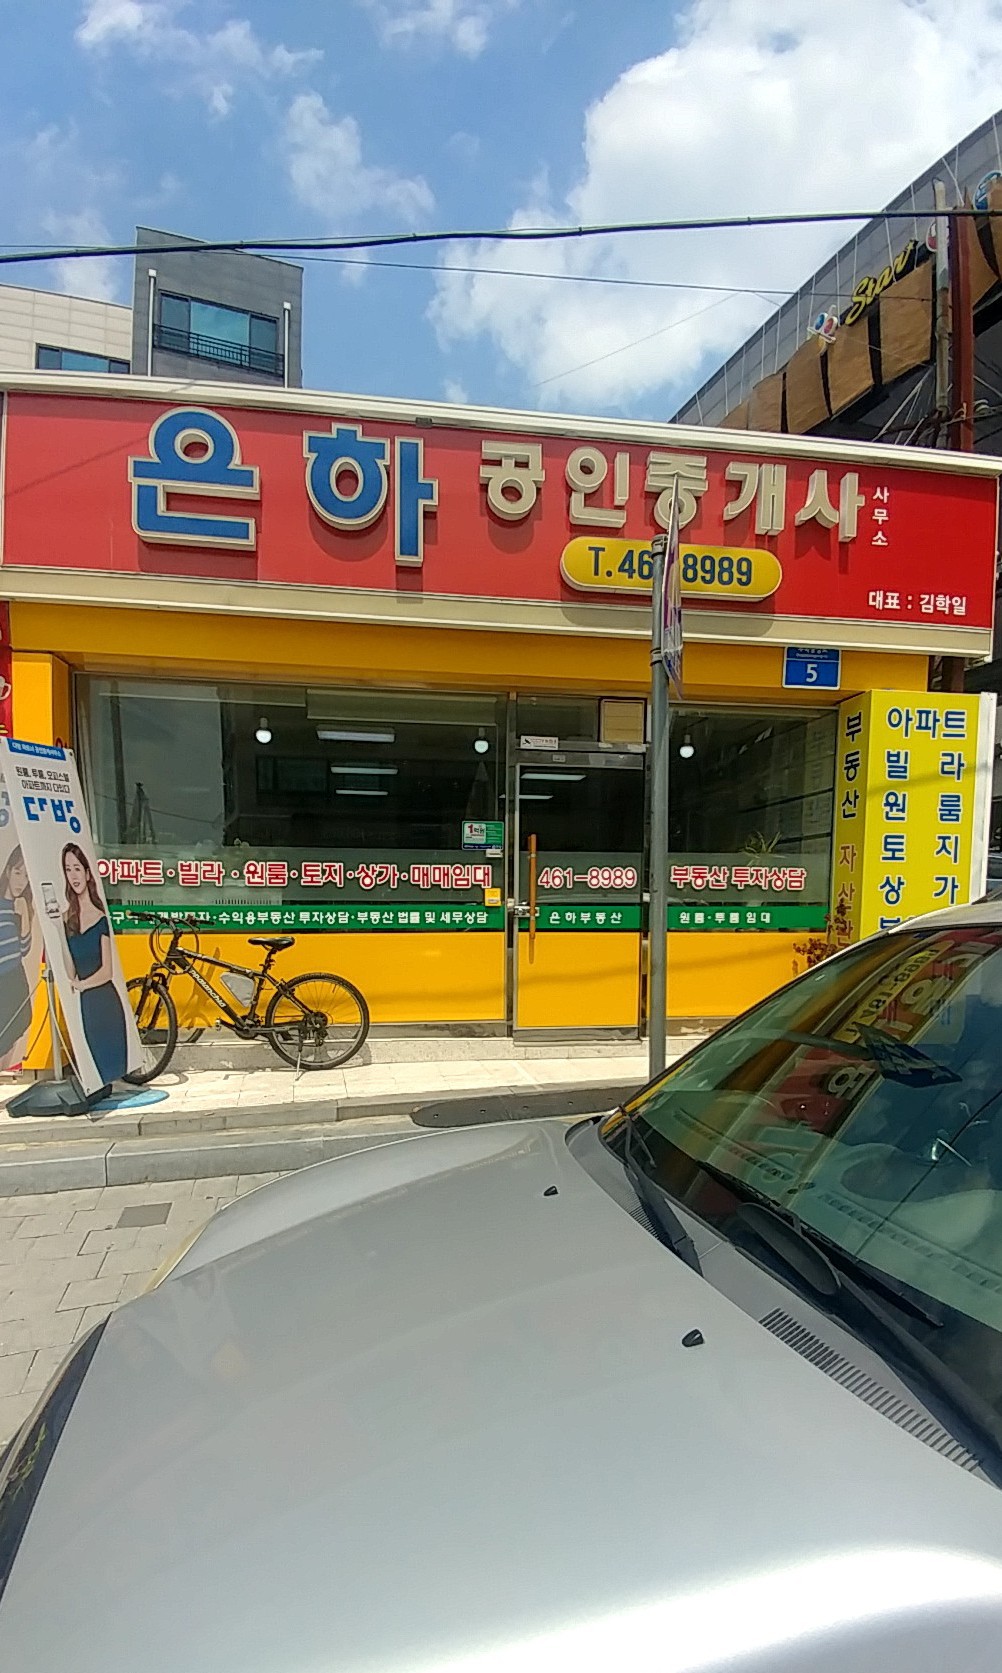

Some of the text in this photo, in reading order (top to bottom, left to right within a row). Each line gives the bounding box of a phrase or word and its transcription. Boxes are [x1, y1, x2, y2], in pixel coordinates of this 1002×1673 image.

[128, 406, 864, 567] 은하 공인중개사
[871, 486, 890, 546] 사무소
[588, 545, 753, 587] T.468989
[868, 590, 901, 611] 대표
[919, 594, 967, 616] 김학일
[806, 663, 818, 683] 5
[886, 706, 967, 739] 아파트
[841, 711, 862, 819] 부동산
[885, 750, 966, 781] 빌라
[22, 796, 81, 834] 다방
[883, 790, 963, 823] 원룸
[880, 834, 960, 865] 토지
[97, 859, 492, 889] 아파트 빌라 원룸 토지 상가 매매임대
[537, 866, 638, 889] 461-8989
[670, 865, 807, 891] 부동산 투자상담
[878, 875, 960, 906] 상가
[356, 911, 395, 925] 부동산
[424, 911, 436, 924] 및
[439, 911, 489, 925] 세무상담
